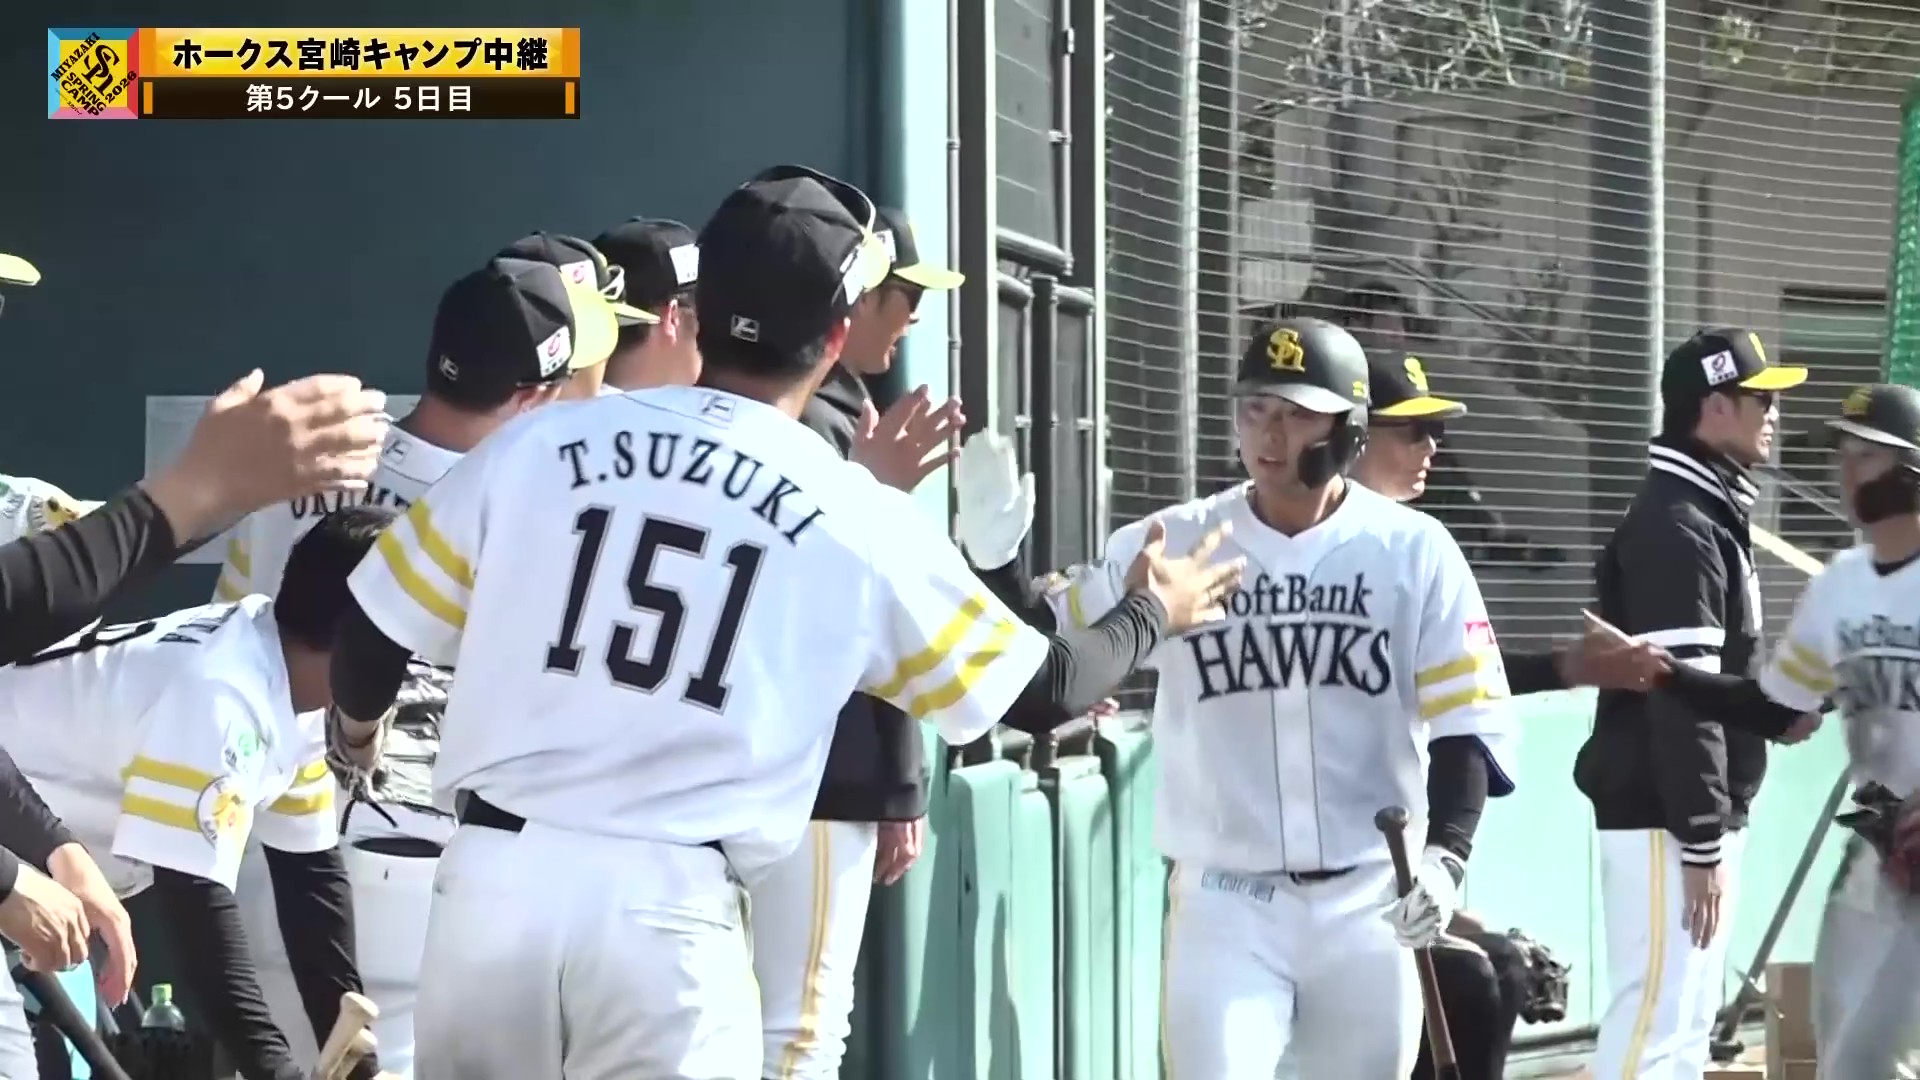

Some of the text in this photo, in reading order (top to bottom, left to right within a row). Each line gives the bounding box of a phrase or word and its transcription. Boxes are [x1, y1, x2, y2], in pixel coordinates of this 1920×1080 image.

[558, 430, 825, 547] T.SUZUKI
[542, 502, 768, 716] 151
[1224, 571, 1374, 619] oftBank
[1183, 620, 1392, 703] HAWKS
